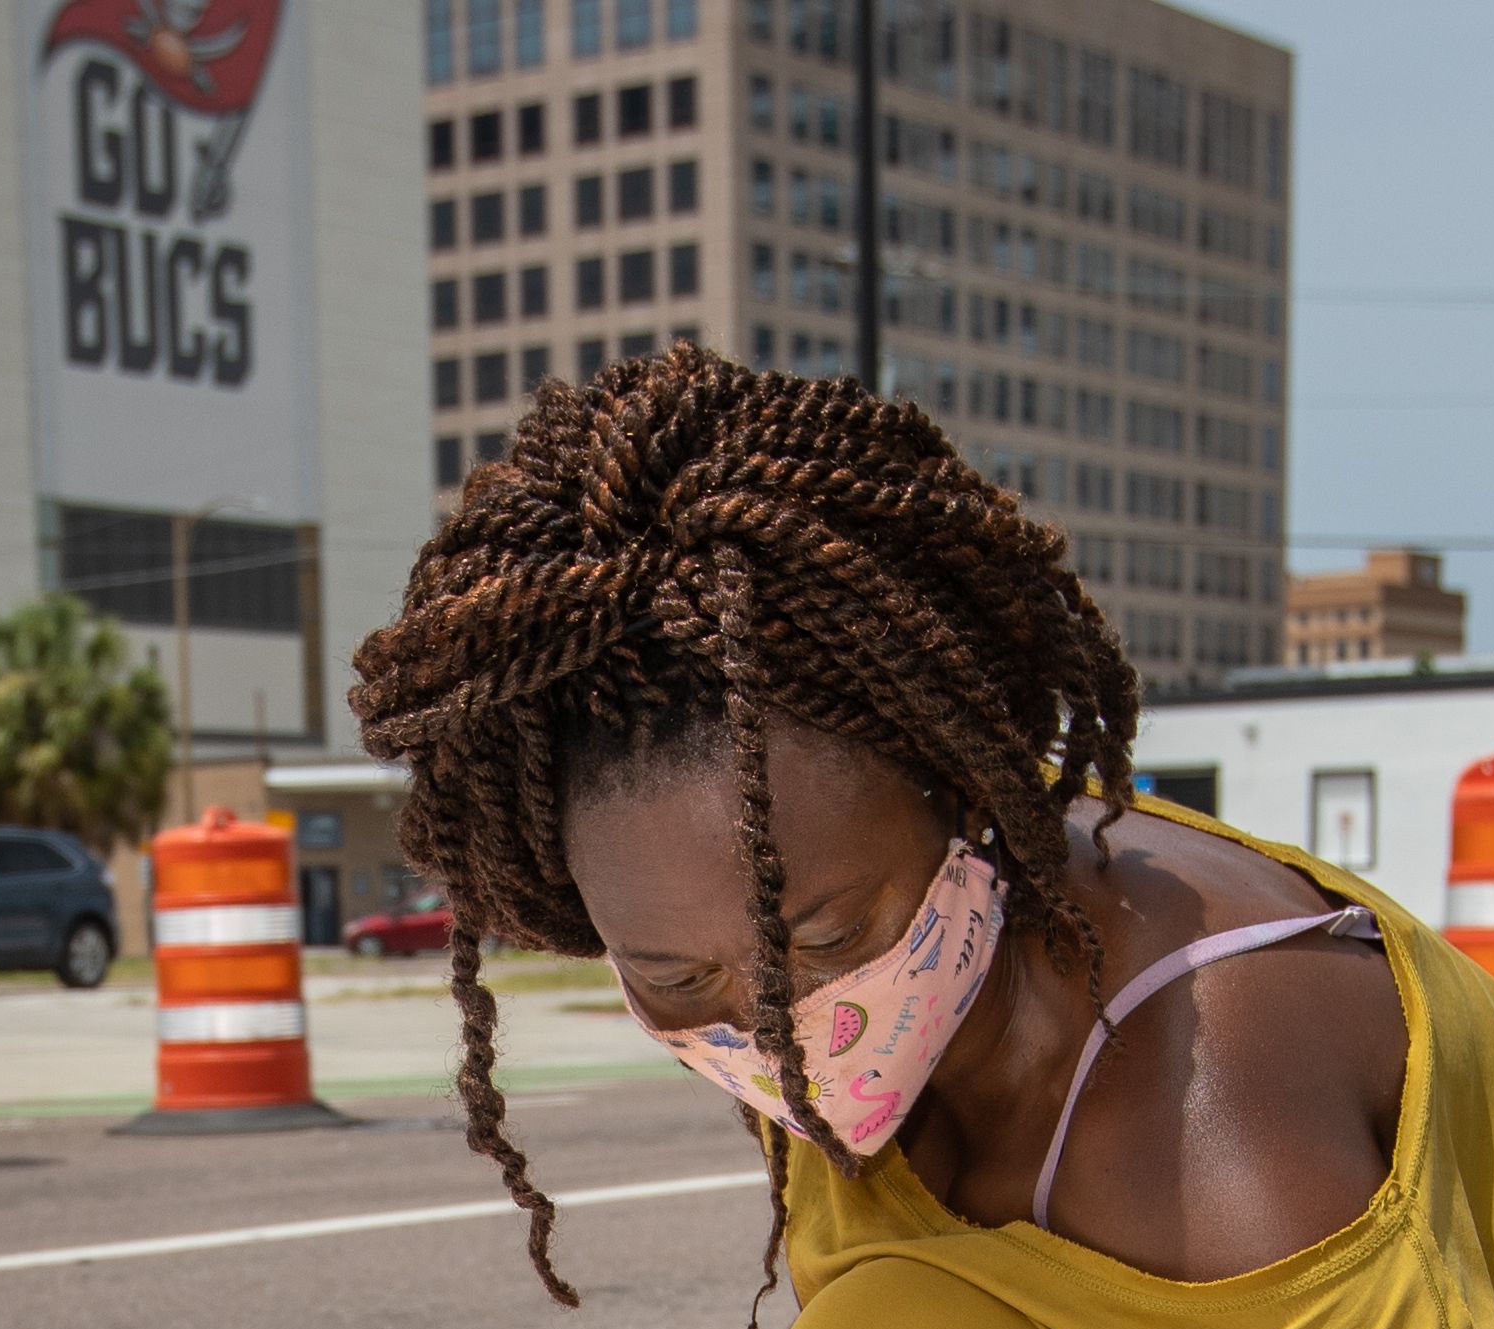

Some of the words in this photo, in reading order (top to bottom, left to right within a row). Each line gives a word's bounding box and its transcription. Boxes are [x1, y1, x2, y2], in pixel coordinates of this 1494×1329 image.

[77, 59, 176, 220] GO
[60, 214, 253, 391] BUCS
[954, 908, 984, 980] hello
